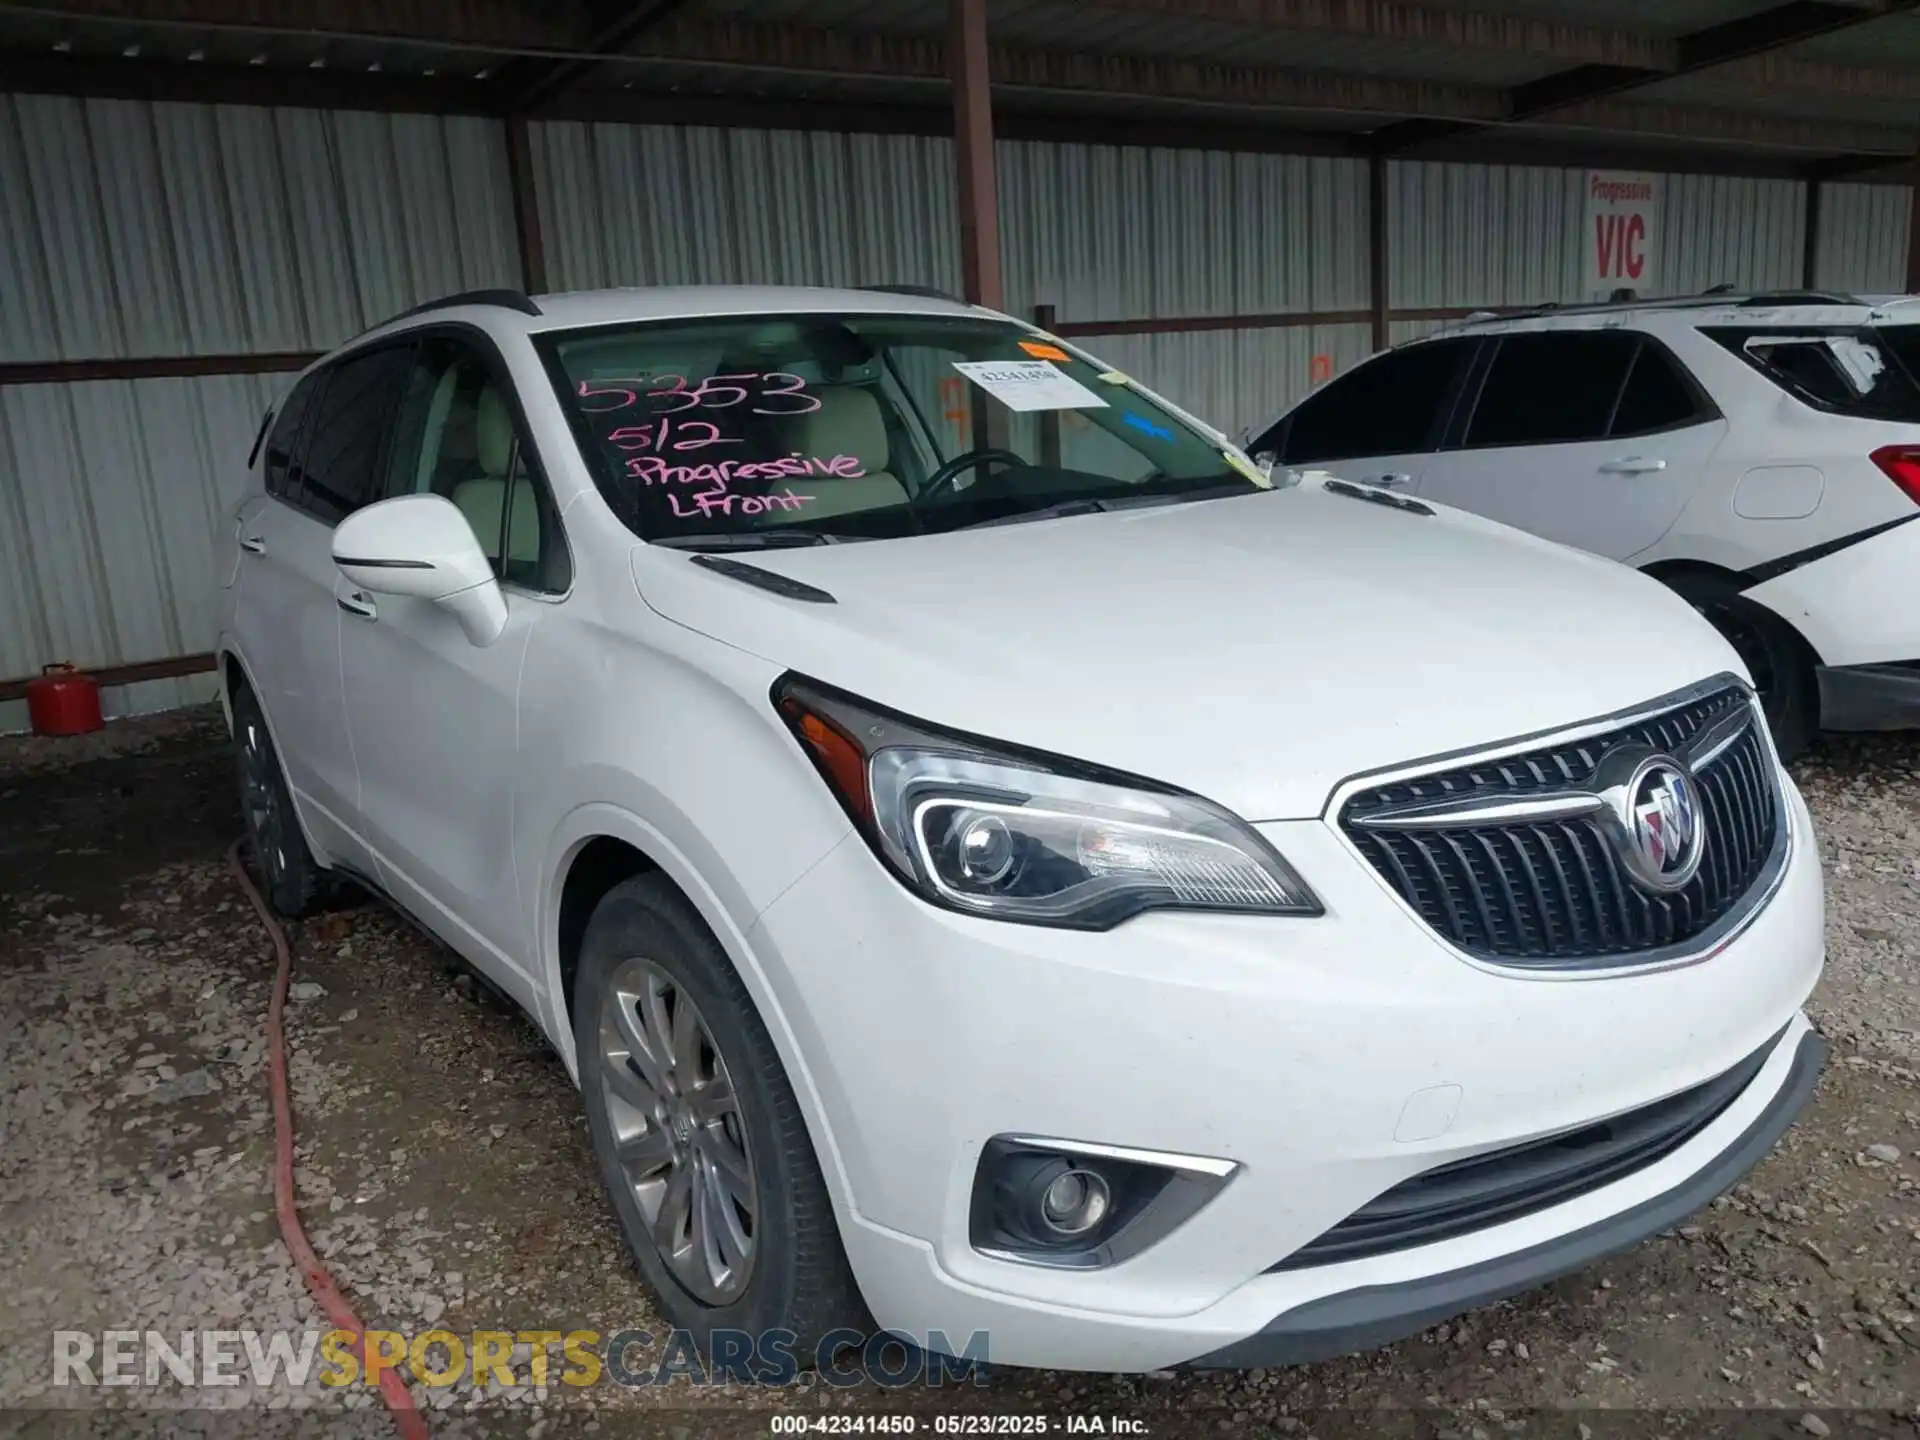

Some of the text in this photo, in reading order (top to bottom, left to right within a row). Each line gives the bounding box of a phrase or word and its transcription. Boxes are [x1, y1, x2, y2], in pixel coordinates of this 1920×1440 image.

[1590, 176, 1652, 205] Progressive
[1595, 213, 1645, 279] VIC
[577, 373, 822, 414] 5353
[625, 452, 866, 493] Progressive
